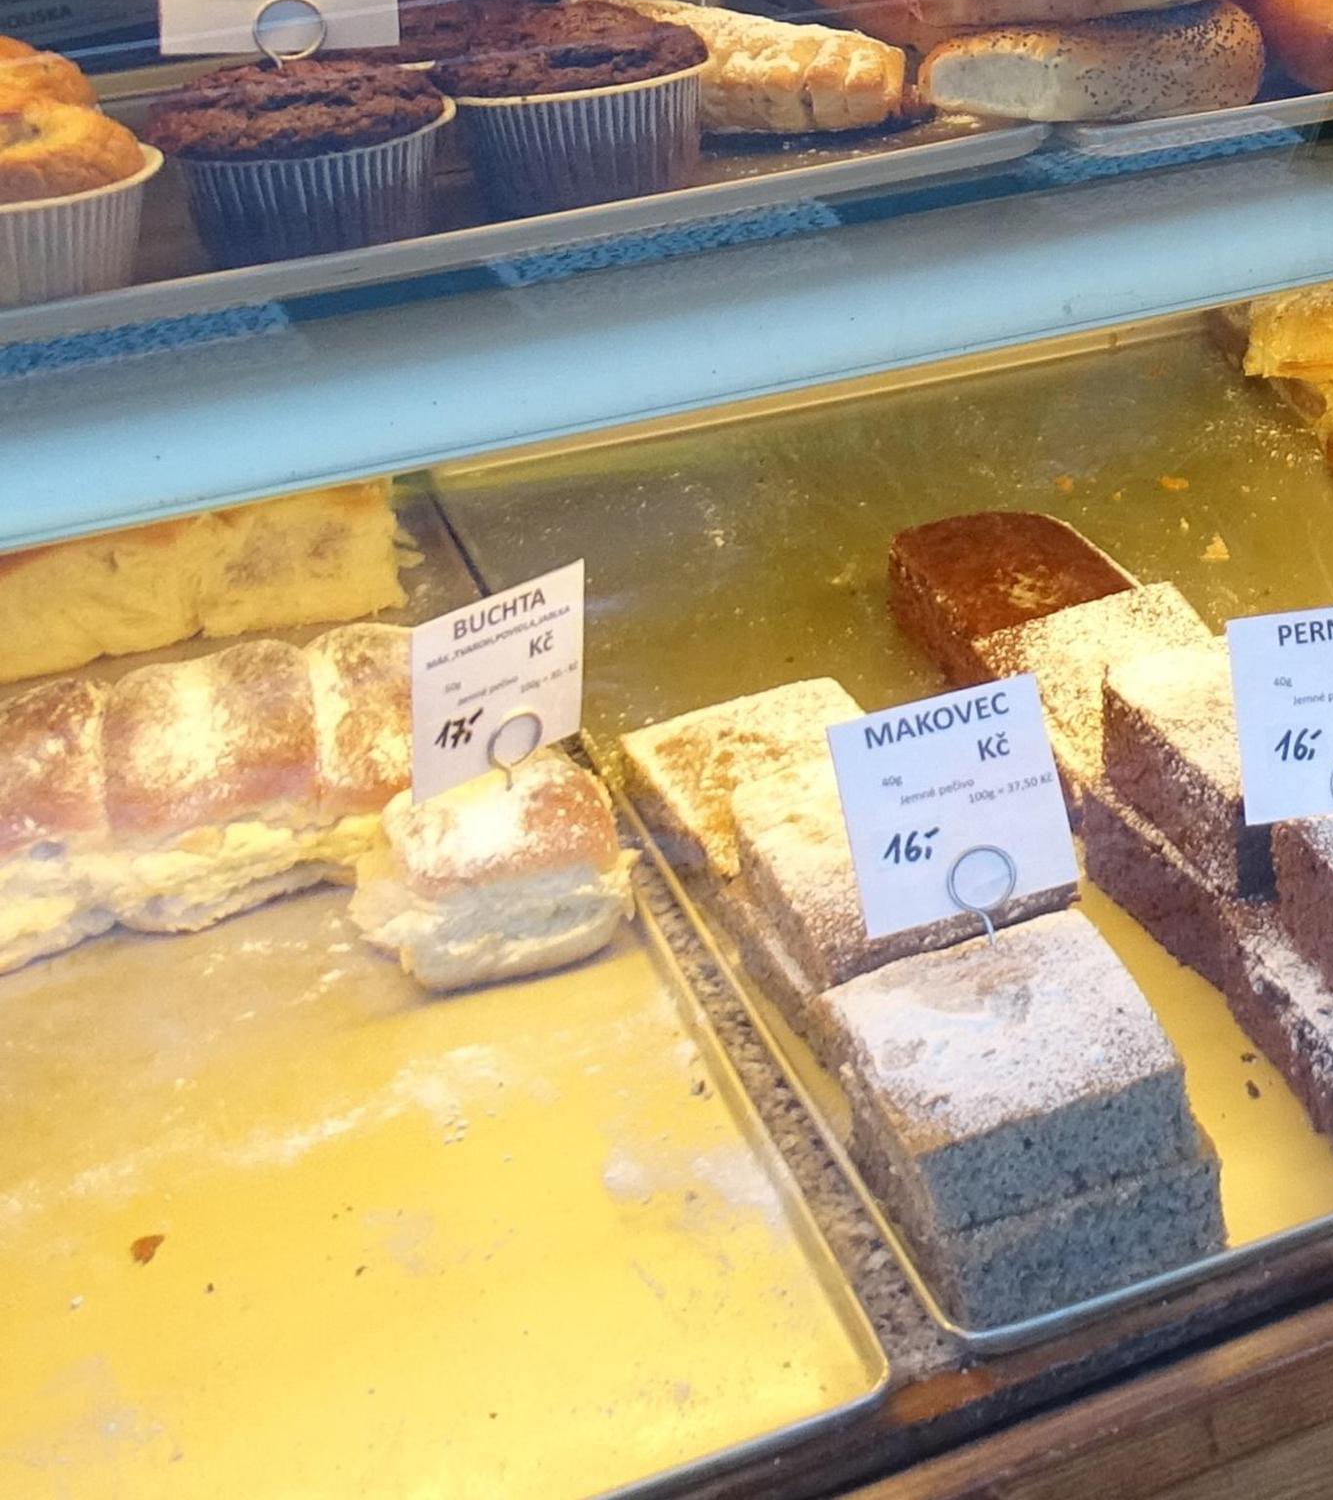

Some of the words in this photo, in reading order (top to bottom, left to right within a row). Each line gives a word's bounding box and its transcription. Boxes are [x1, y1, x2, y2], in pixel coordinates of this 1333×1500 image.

[453, 587, 546, 641] BUCHTA
[528, 629, 554, 658] Kč
[864, 691, 1010, 750] MAKOVEC
[977, 732, 1010, 762] Kč
